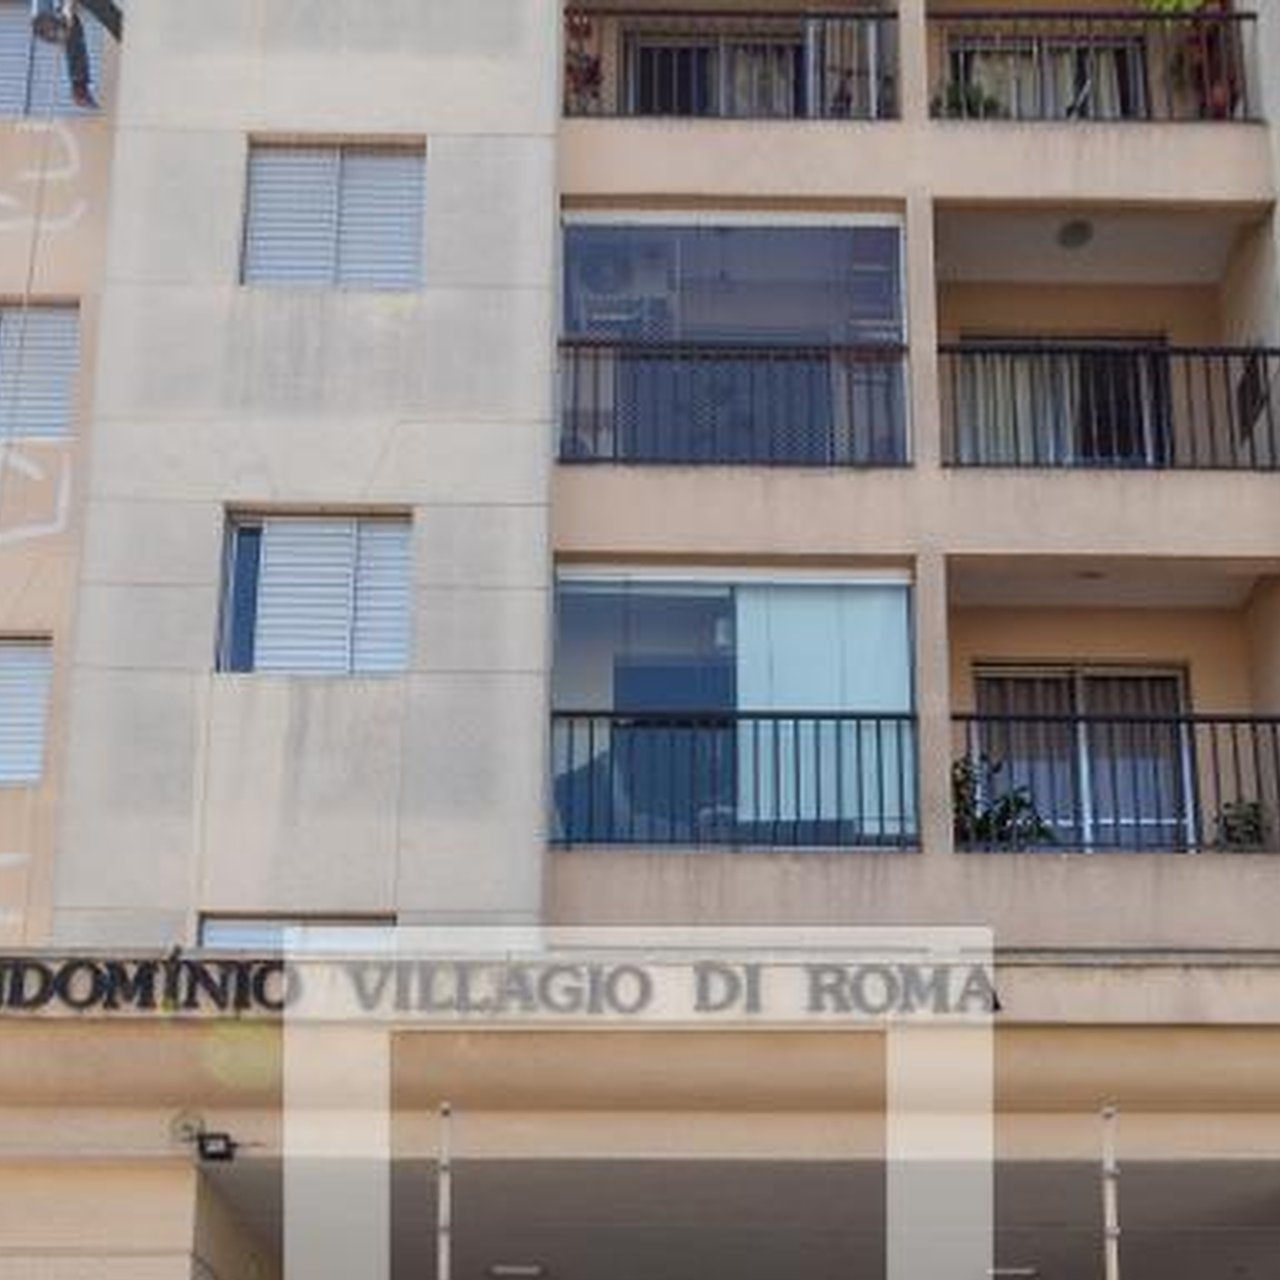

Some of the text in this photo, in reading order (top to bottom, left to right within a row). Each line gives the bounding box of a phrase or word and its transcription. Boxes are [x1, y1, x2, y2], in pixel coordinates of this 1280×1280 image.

[344, 957, 653, 1014] VILLAGIO
[692, 960, 762, 1014] DI
[802, 961, 1003, 1014] ROMA
